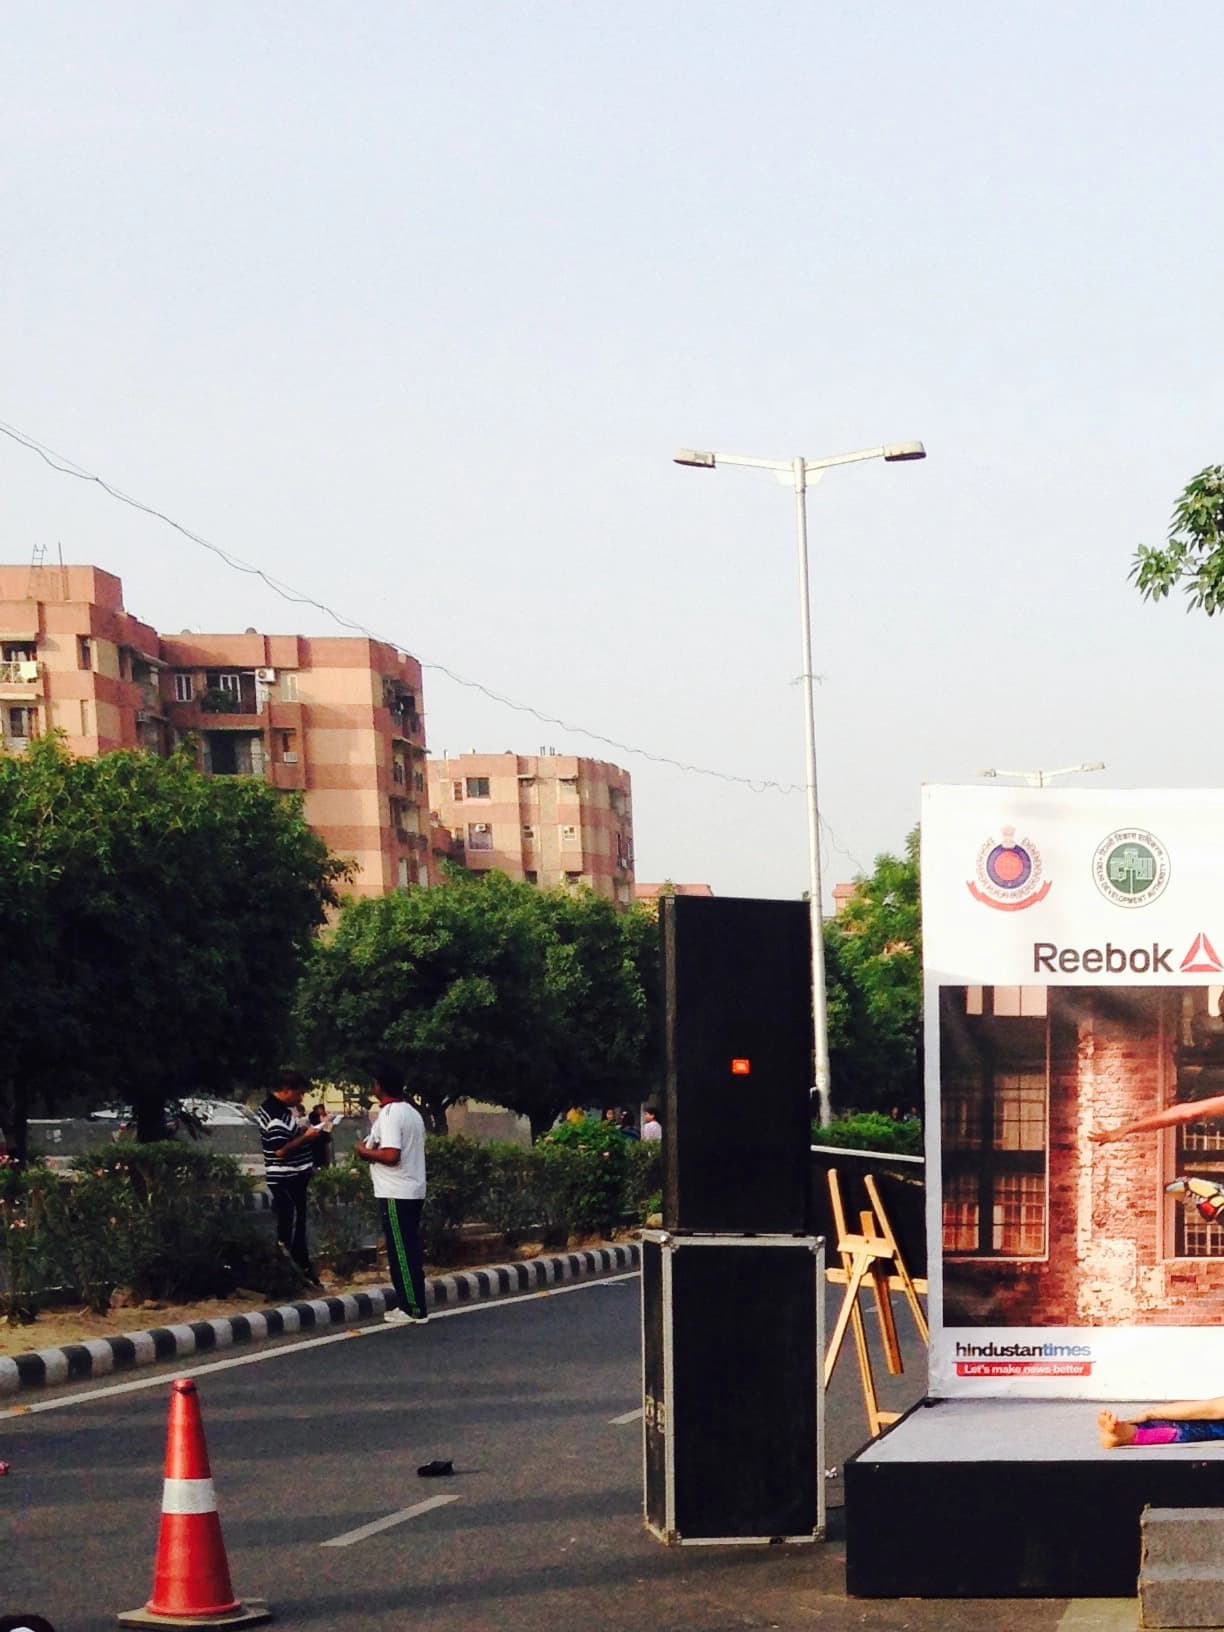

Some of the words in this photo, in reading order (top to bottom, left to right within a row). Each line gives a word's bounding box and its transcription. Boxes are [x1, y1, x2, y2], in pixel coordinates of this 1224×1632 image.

[1033, 942, 1174, 973] Reebok
[955, 1341, 1092, 1357] hindustantimes
[964, 1364, 990, 1375] Let's
[992, 1364, 1021, 1375] make
[1024, 1366, 1050, 1375] news
[1053, 1364, 1084, 1375] better
